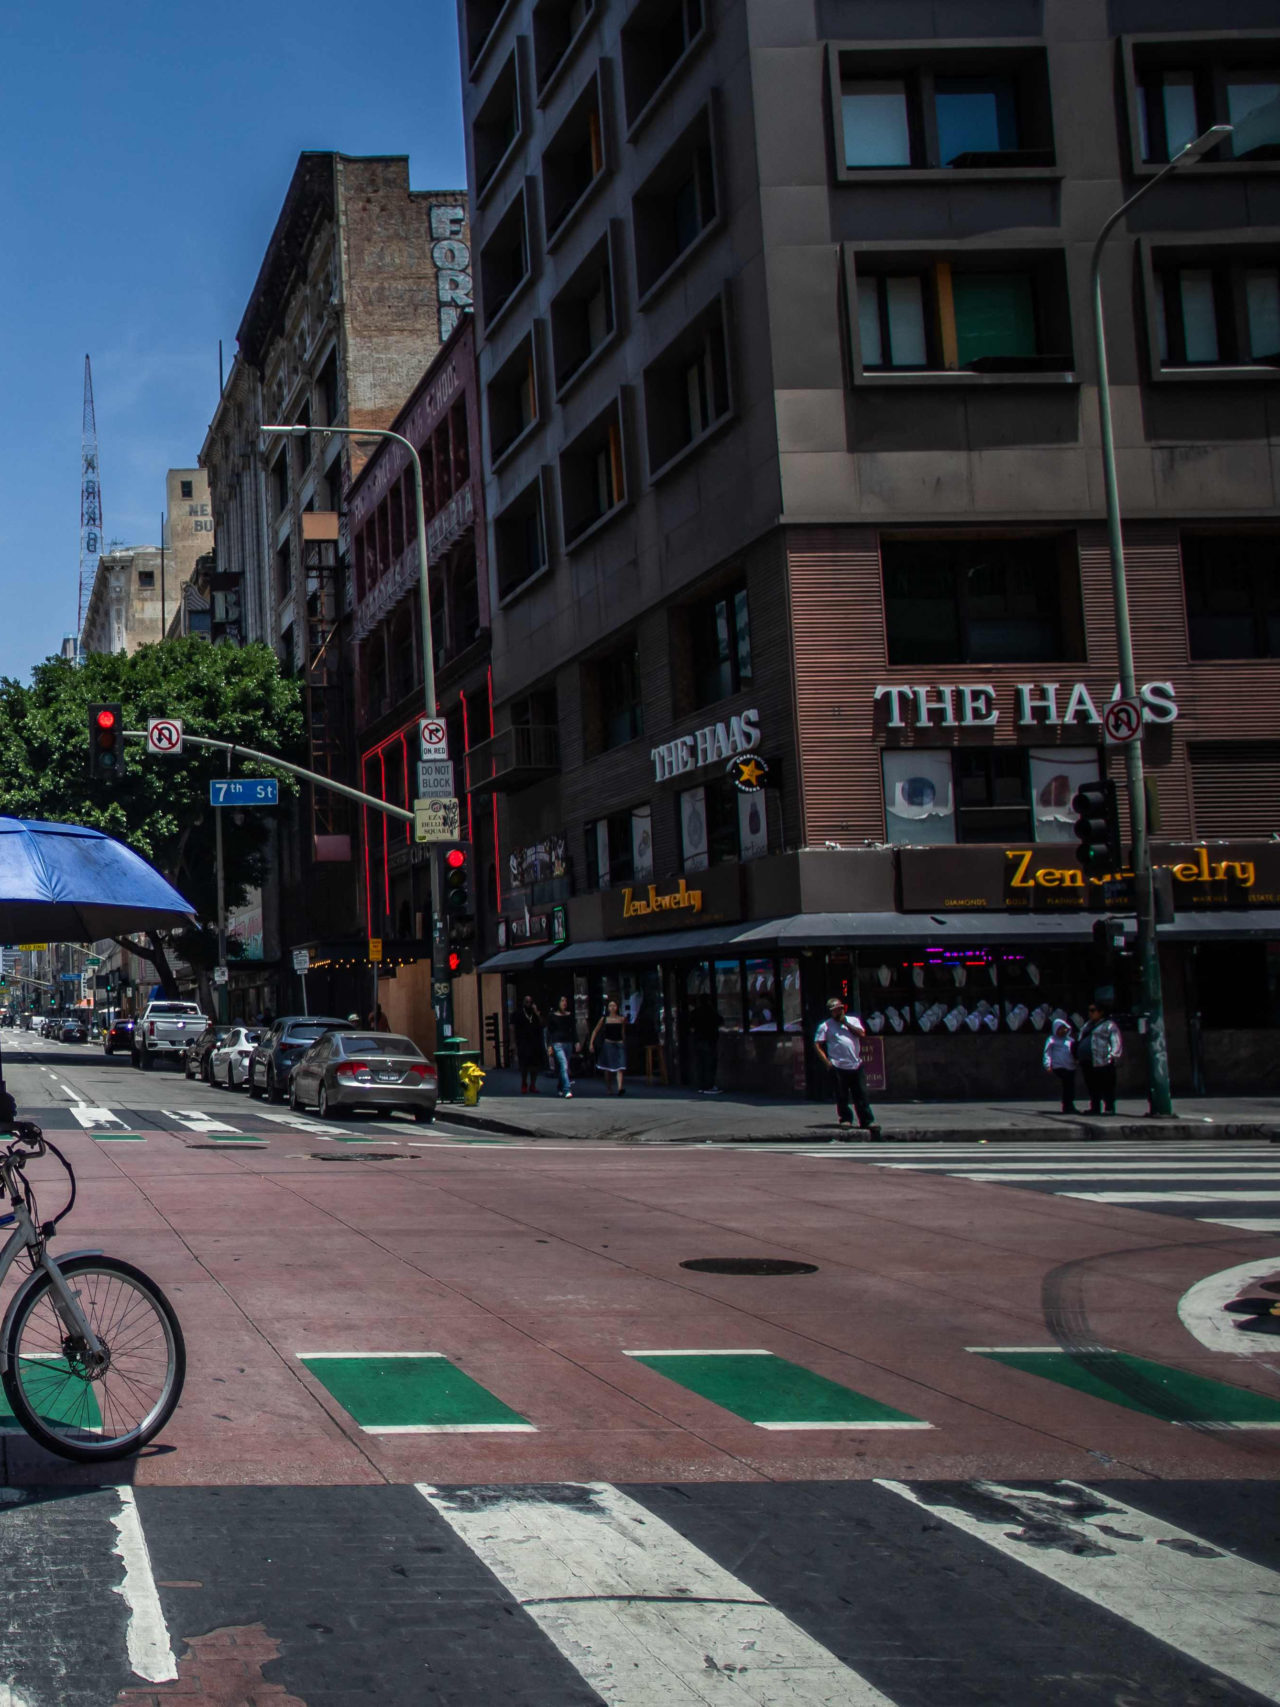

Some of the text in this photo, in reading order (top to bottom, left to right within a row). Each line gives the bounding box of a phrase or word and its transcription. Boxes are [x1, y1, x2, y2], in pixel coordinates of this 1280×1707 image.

[873, 682, 1180, 728] THE HAS
[423, 747, 446, 755] ON RED
[651, 708, 762, 783] THE HAAS
[421, 765, 450, 776] DO NOT
[422, 778, 451, 788] BLOCK
[215, 783, 273, 802] 7th St
